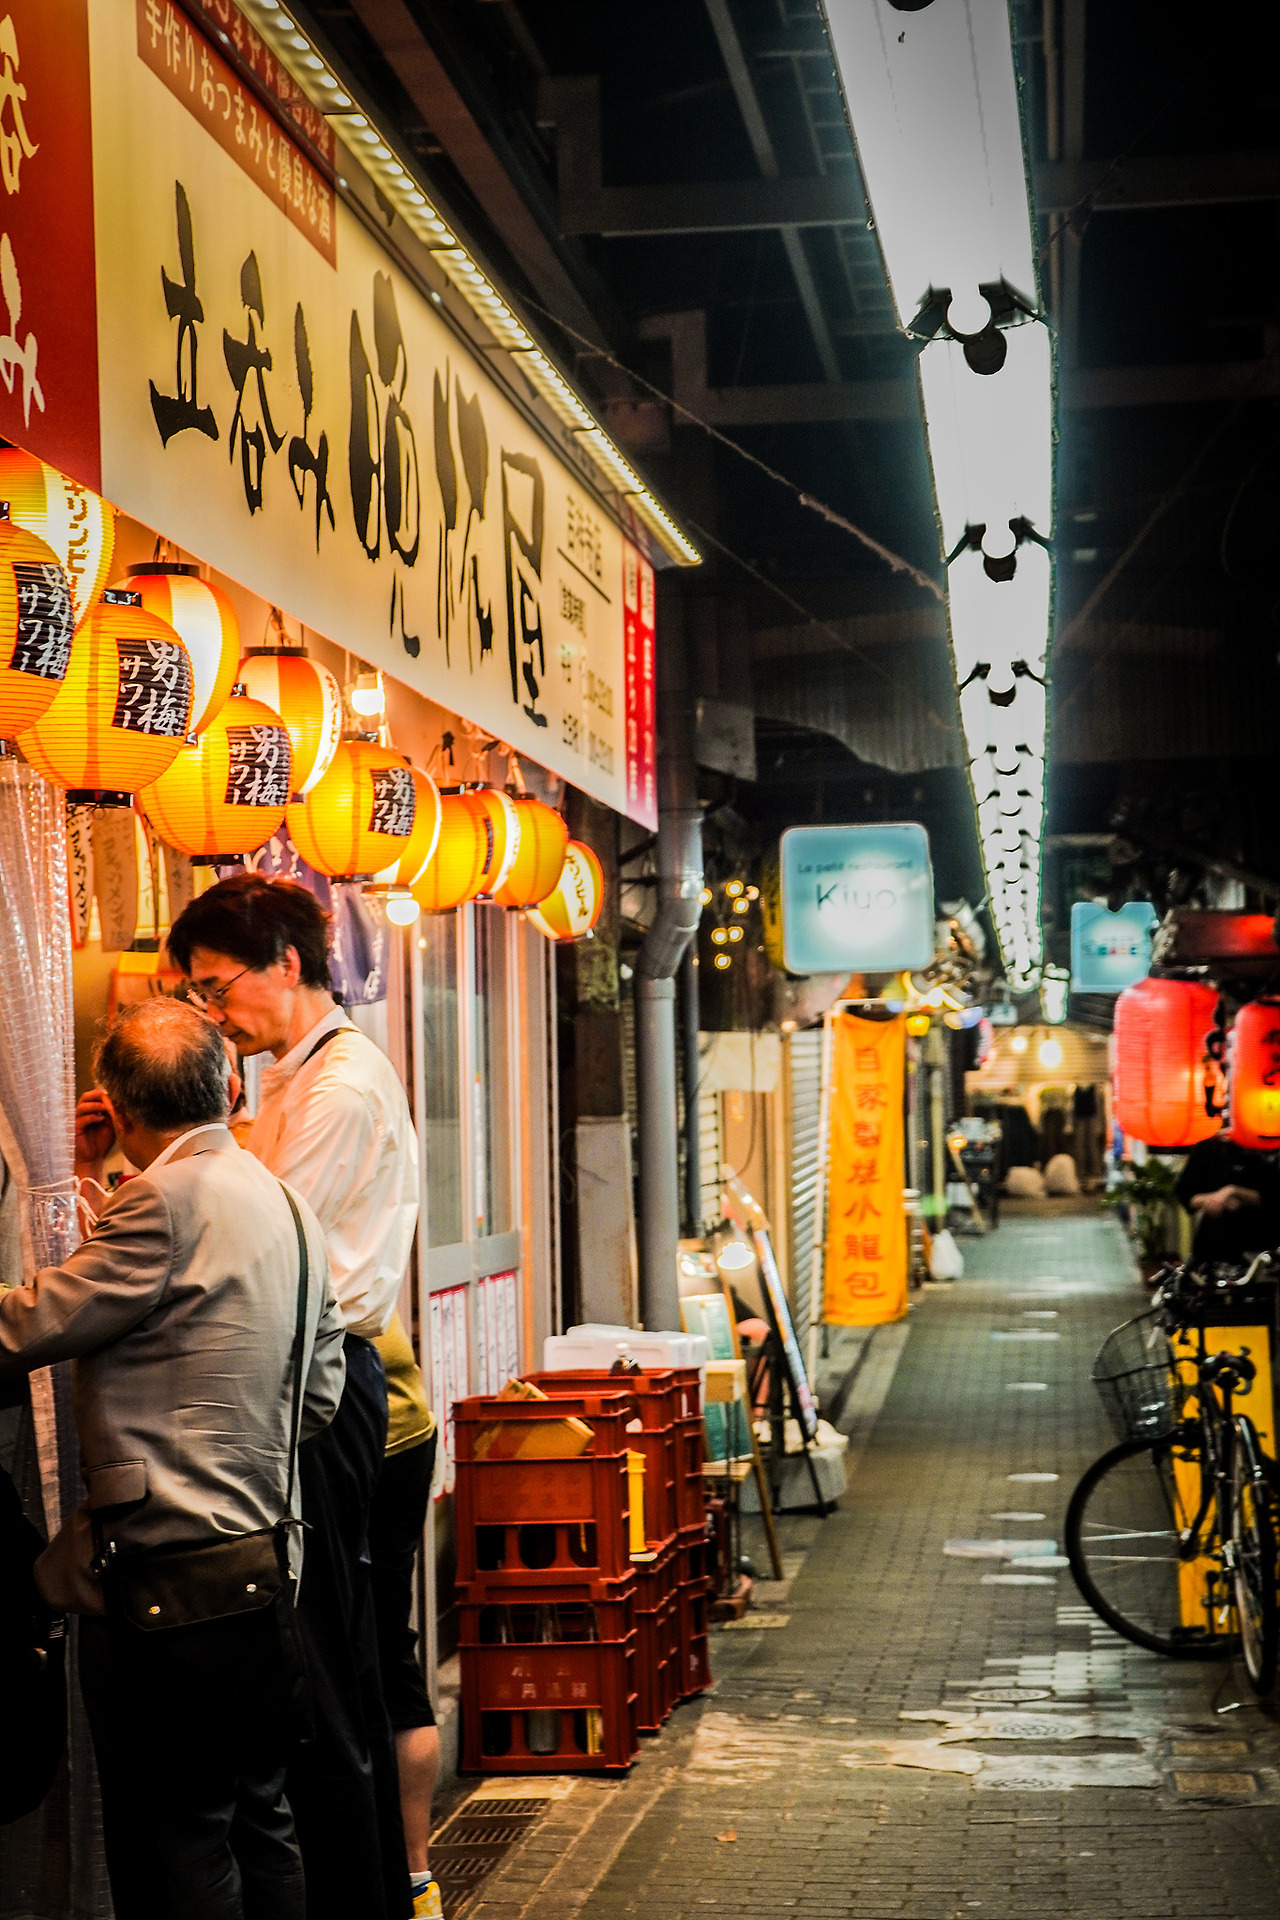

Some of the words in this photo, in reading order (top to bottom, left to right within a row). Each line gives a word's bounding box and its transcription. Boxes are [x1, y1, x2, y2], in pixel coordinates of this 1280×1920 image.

[18, 584, 47, 672] サワー
[120, 655, 149, 729] サワー
[137, 640, 181, 737] 男梅
[229, 741, 255, 806] サワー
[245, 725, 281, 806] 男梅
[374, 779, 393, 832] サワー
[816, 883, 897, 911] Kiyo
